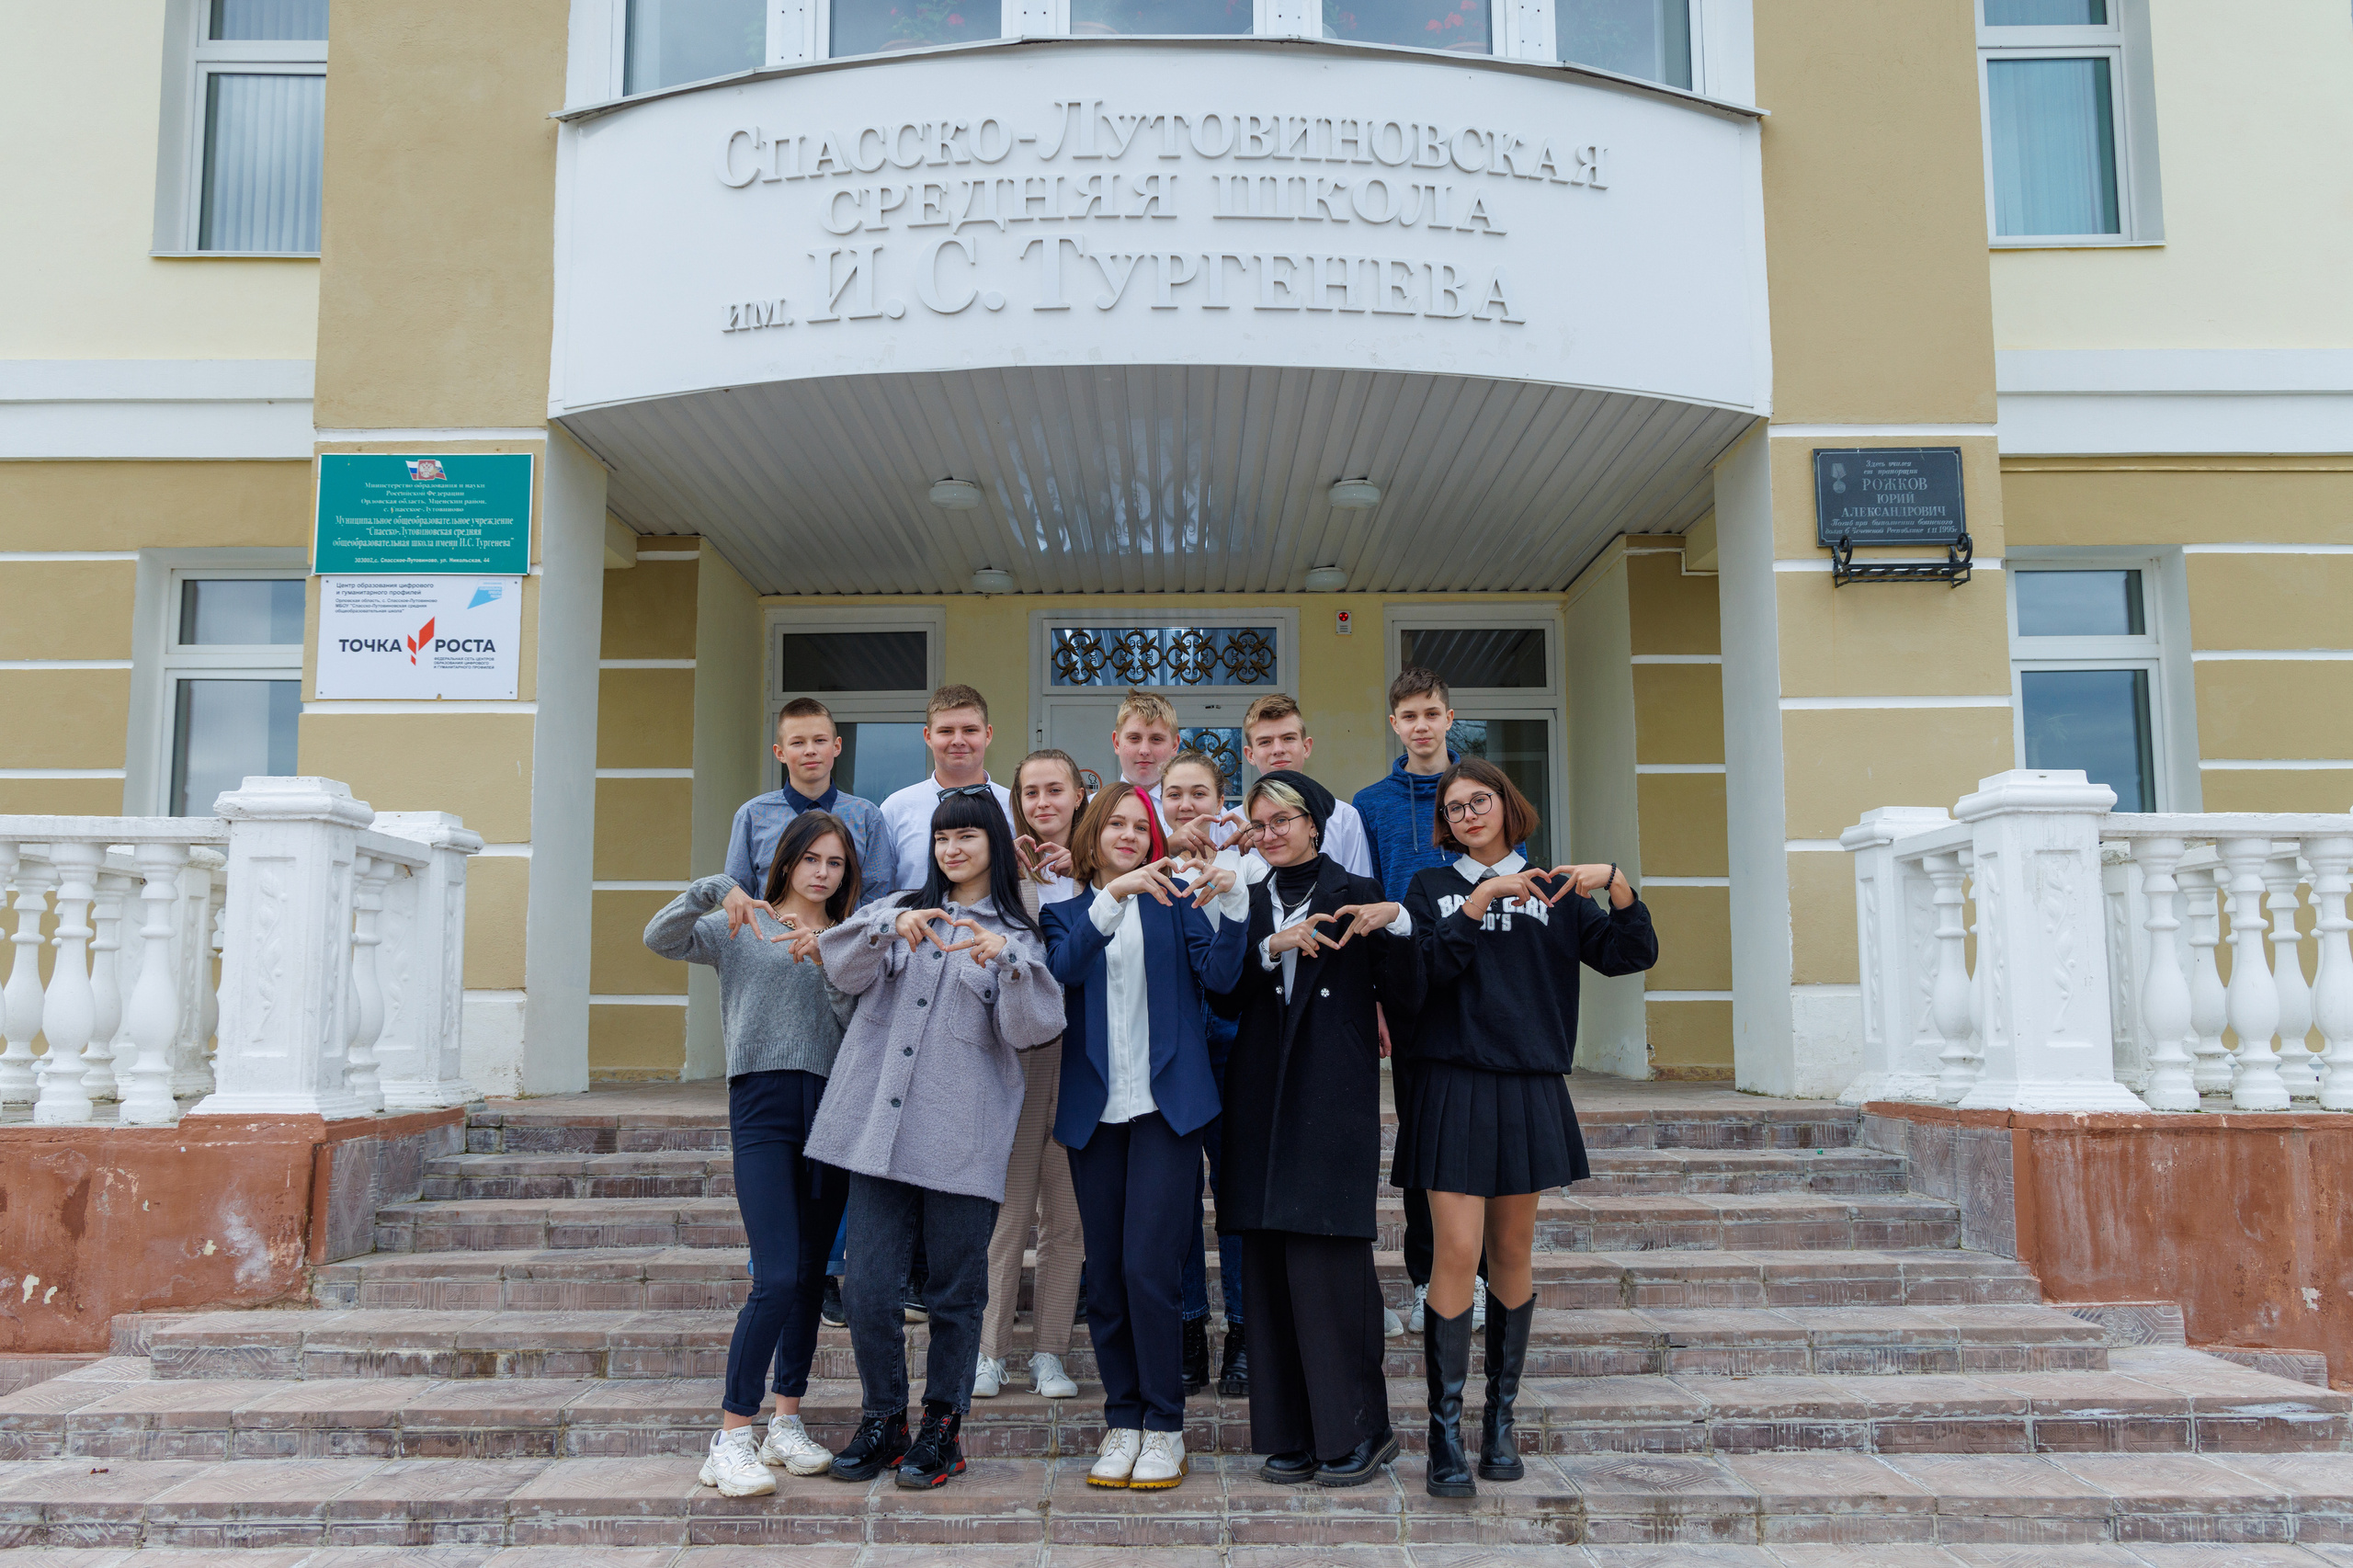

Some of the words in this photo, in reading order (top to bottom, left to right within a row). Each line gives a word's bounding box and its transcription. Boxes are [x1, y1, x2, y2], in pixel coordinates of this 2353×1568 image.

[820, 172, 1177, 234] СРЕДНЯЯ
[1212, 174, 1508, 235] ШКОЛА
[1019, 233, 1527, 324] ТУРГЕНЕВА
[1862, 477, 1928, 491] РОЖКОВ
[1877, 492, 1915, 503] ЮРИЙ
[1841, 506, 1946, 517] АЛЕКСАНДРОВИЧ
[335, 515, 392, 526] Муниципальное
[393, 515, 470, 527] общеобразовательное
[471, 518, 514, 527] учреждение
[454, 529, 482, 538] средняя
[332, 537, 409, 549] общеобразовательная
[339, 639, 402, 652] ТОЧКА
[435, 639, 496, 652] РОСТА
